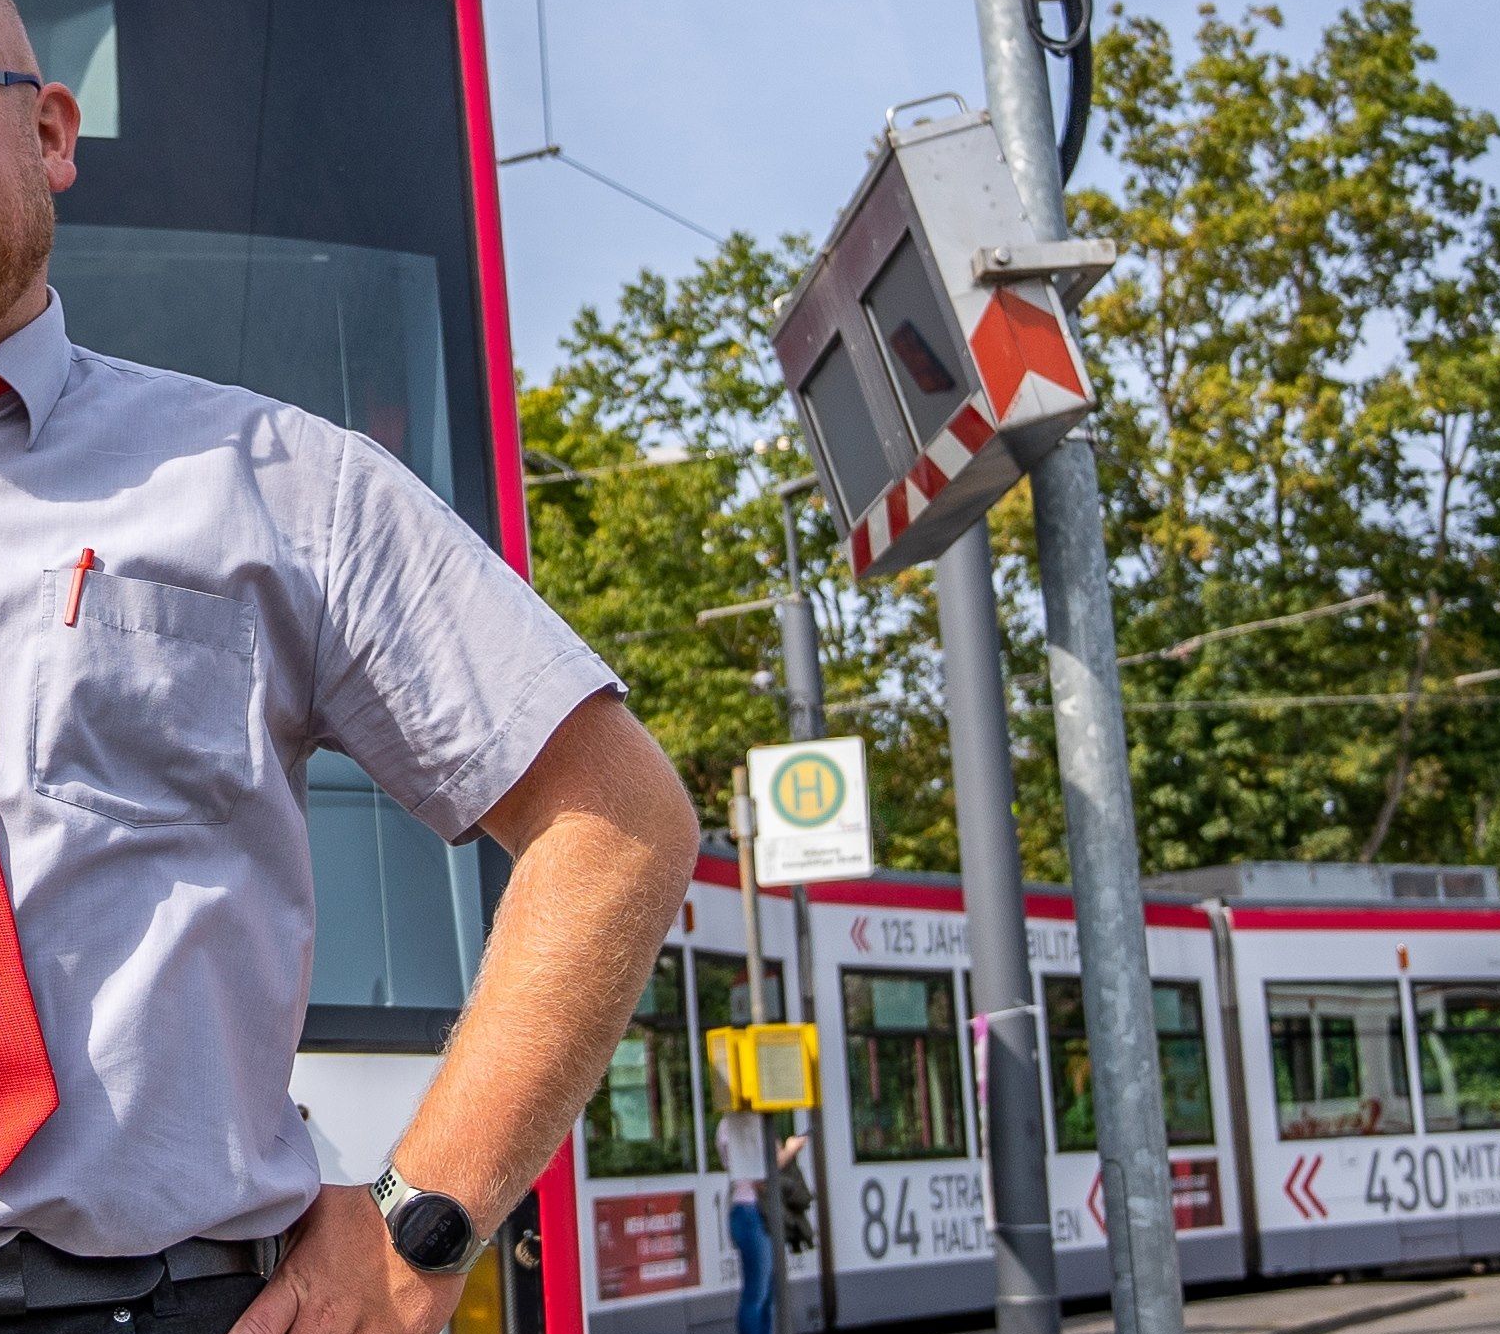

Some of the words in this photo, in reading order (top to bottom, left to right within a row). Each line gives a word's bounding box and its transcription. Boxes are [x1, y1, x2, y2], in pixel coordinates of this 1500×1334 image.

[793, 769, 823, 812] H
[881, 918, 916, 955] 125
[924, 920, 968, 955] JAH
[929, 1174, 984, 1210] STRA
[1366, 1147, 1448, 1212] 430
[861, 1176, 920, 1259] 84
